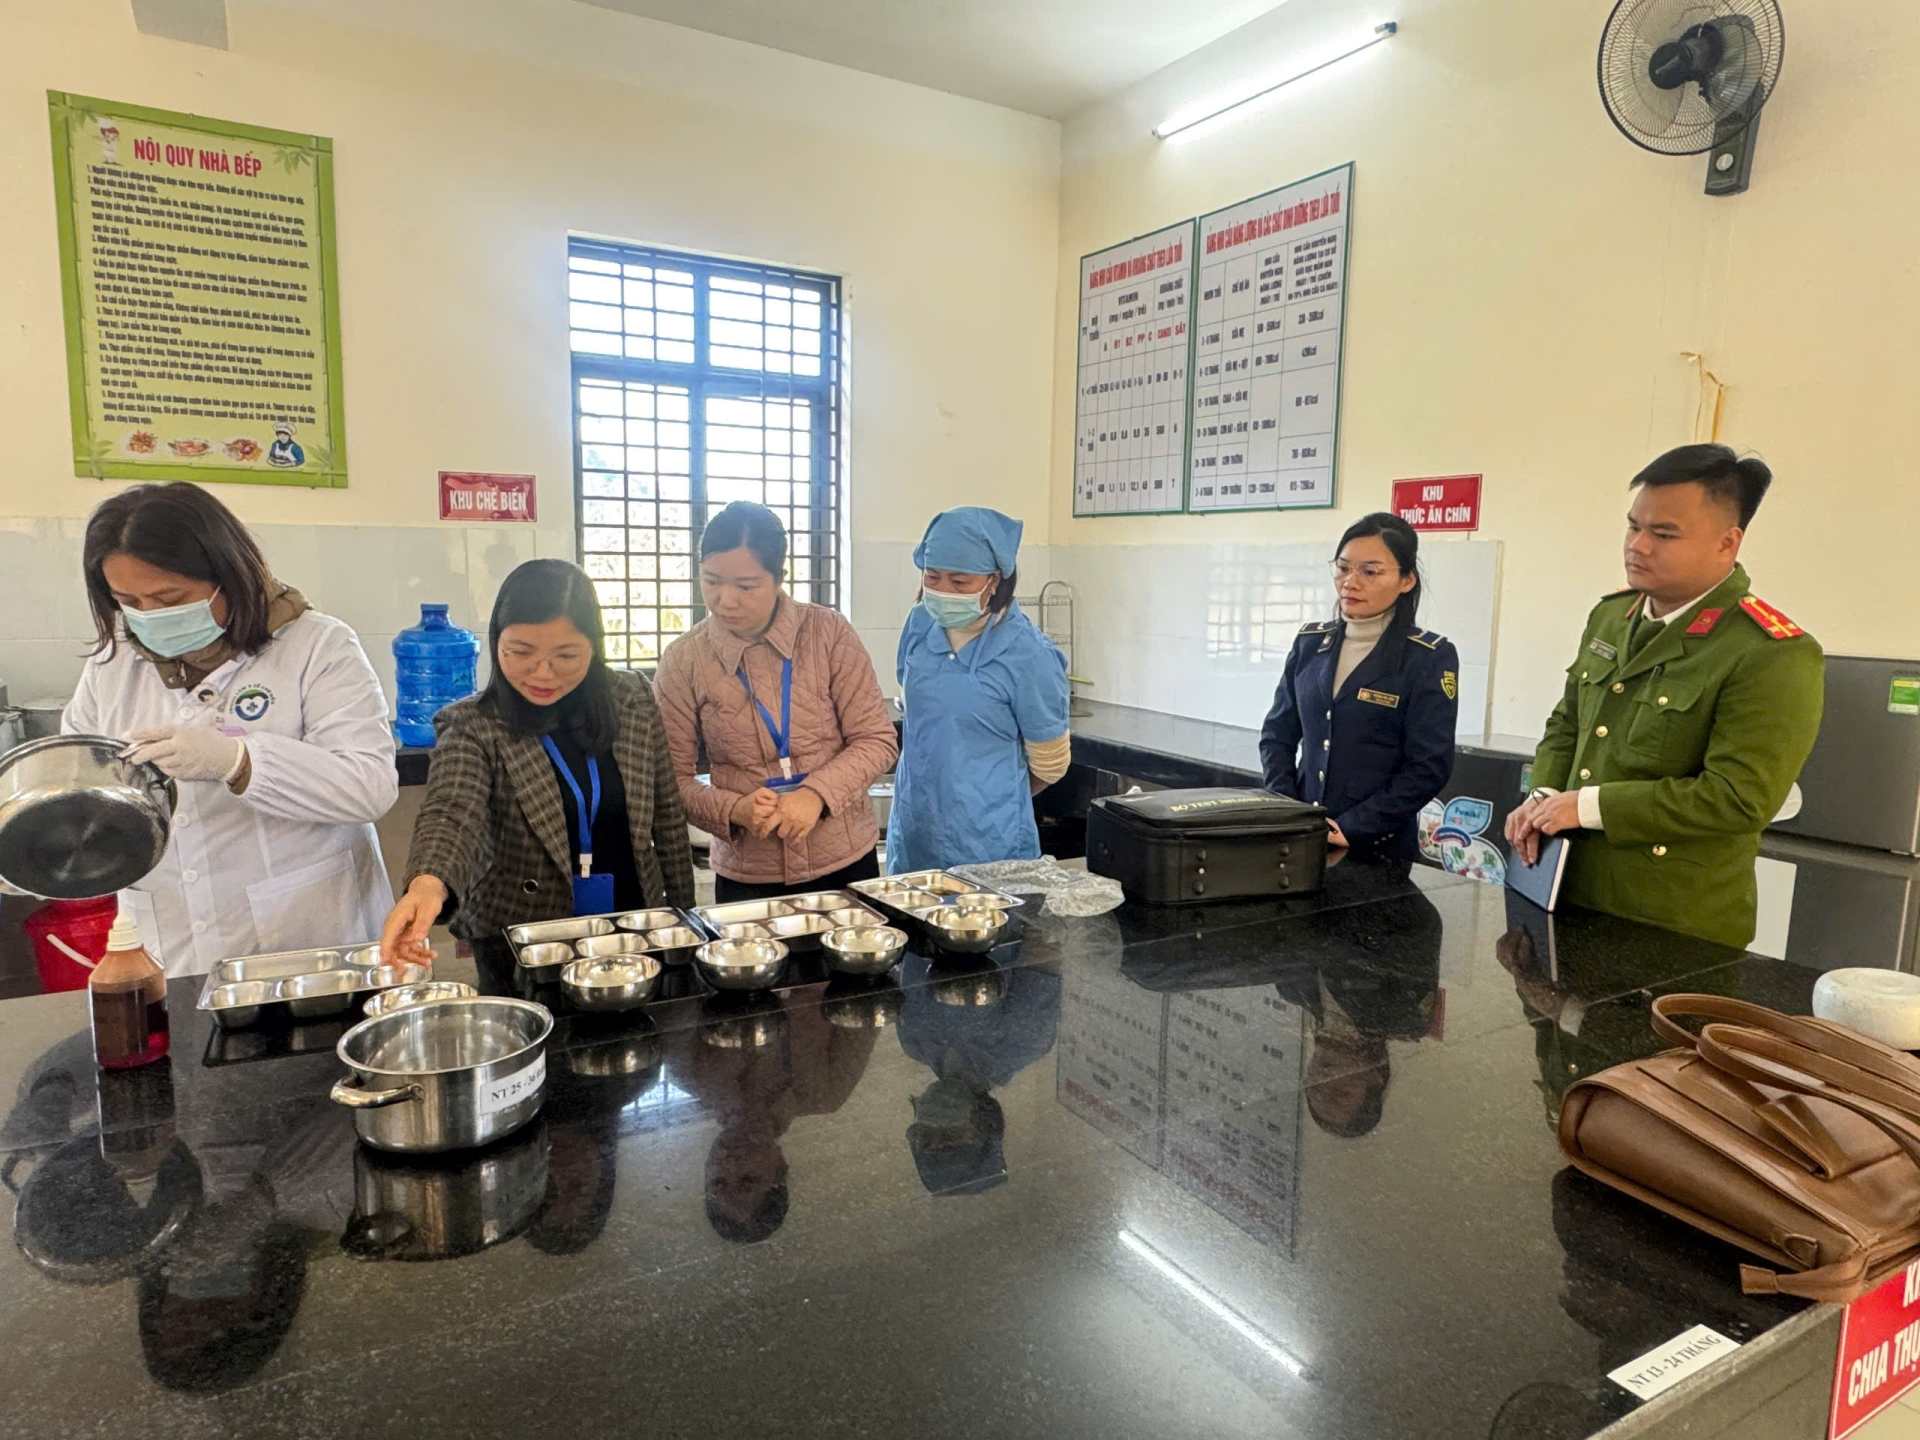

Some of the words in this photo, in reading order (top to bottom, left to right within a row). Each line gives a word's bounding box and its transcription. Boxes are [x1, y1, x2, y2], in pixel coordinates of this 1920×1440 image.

[134, 136, 161, 166] NỘI
[166, 144, 194, 168] QUY
[199, 149, 230, 174] NHÀ
[234, 151, 262, 178] BẾP
[1118, 291, 1139, 306] VITAMIN
[449, 490, 472, 510] KHU
[476, 485, 498, 510] CHẾ
[500, 486, 527, 511] BIẾN
[1422, 485, 1444, 502] KHU
[1427, 505, 1442, 524] ĂN
[1445, 503, 1471, 523] CHÍN
[492, 1087, 509, 1102] NT
[511, 1081, 521, 1095] 25
[1627, 1373, 1651, 1389] NT
[1646, 1366, 1665, 1378] 13
[1664, 1355, 1683, 1369] 24
[1676, 1334, 1721, 1360] THÁNG
[1848, 1340, 1889, 1407] CHIA
